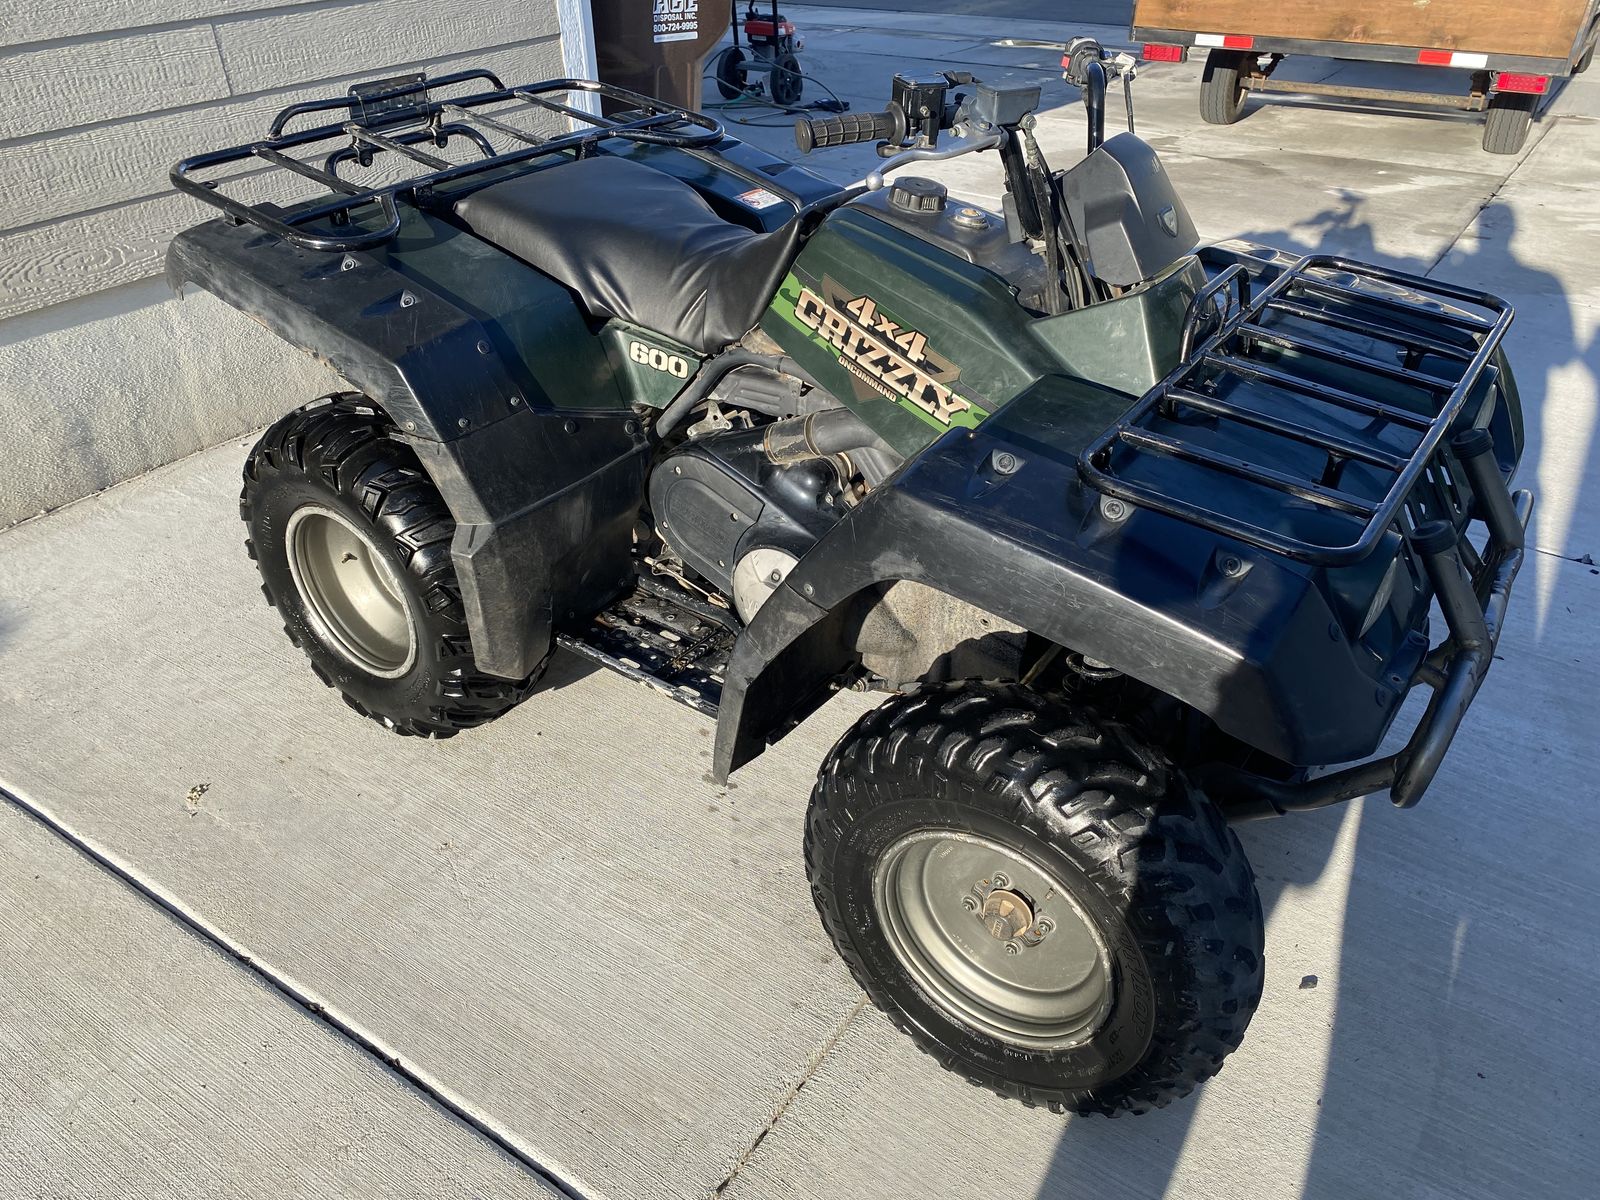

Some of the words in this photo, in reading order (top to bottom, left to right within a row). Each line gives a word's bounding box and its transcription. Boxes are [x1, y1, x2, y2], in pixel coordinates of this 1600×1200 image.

[653, 13, 684, 22] DISPOSAL
[684, 12, 698, 20] INC.
[653, 21, 698, 32] 800-724-9995
[629, 340, 689, 379] 600
[794, 287, 972, 426] GRIZZLY
[837, 354, 898, 403] ONCOMMAND
